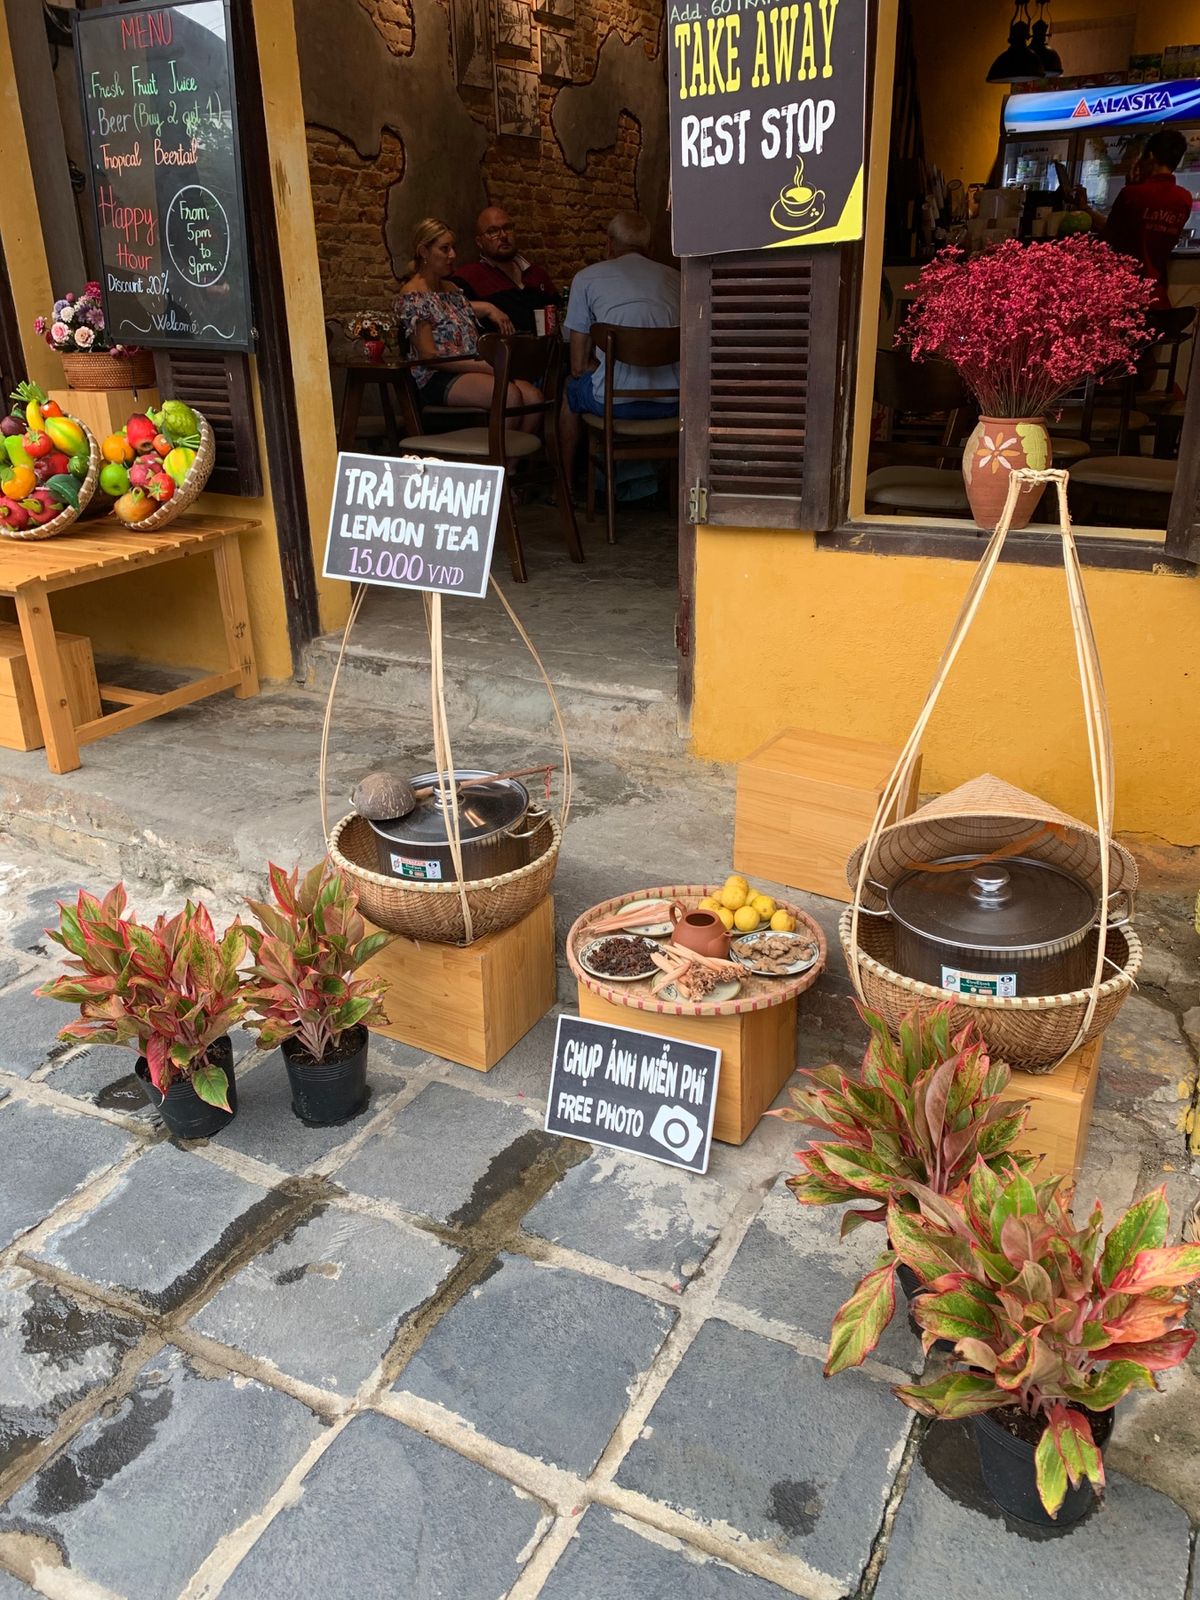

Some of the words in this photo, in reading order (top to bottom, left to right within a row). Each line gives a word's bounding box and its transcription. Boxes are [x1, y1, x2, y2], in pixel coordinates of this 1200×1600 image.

[711, 0, 732, 15] 60
[120, 11, 174, 50] MENU
[674, 13, 741, 100] TAKE
[751, 0, 840, 89] AWAY
[91, 71, 125, 99] Fresh
[131, 65, 159, 97] Fruit
[168, 60, 198, 94] Juice
[98, 107, 132, 136] Beer
[167, 100, 179, 125] 2
[182, 100, 201, 136] get
[1092, 92, 1173, 115] ALASKA
[681, 109, 751, 168] REST
[761, 98, 836, 160] STOP
[100, 141, 142, 177] Tropical
[99, 185, 158, 246] Happy
[179, 200, 210, 221] From
[186, 222, 212, 246] 5pm
[199, 242, 211, 259] to
[116, 243, 153, 271] Hour
[107, 273, 144, 293] Discount
[146, 270, 170, 296] 20%
[345, 462, 395, 510] TRÀ
[403, 473, 492, 520] CHANH
[340, 513, 425, 548] LEMON
[434, 523, 479, 552] TEA
[348, 546, 424, 582] 15.000
[428, 564, 464, 586] VND
[563, 1039, 604, 1087] CHỤP
[604, 1038, 638, 1089] ẢNH
[680, 1064, 708, 1106] PHÍ
[557, 1091, 594, 1123] FREE
[595, 1099, 644, 1138] PHOTO
